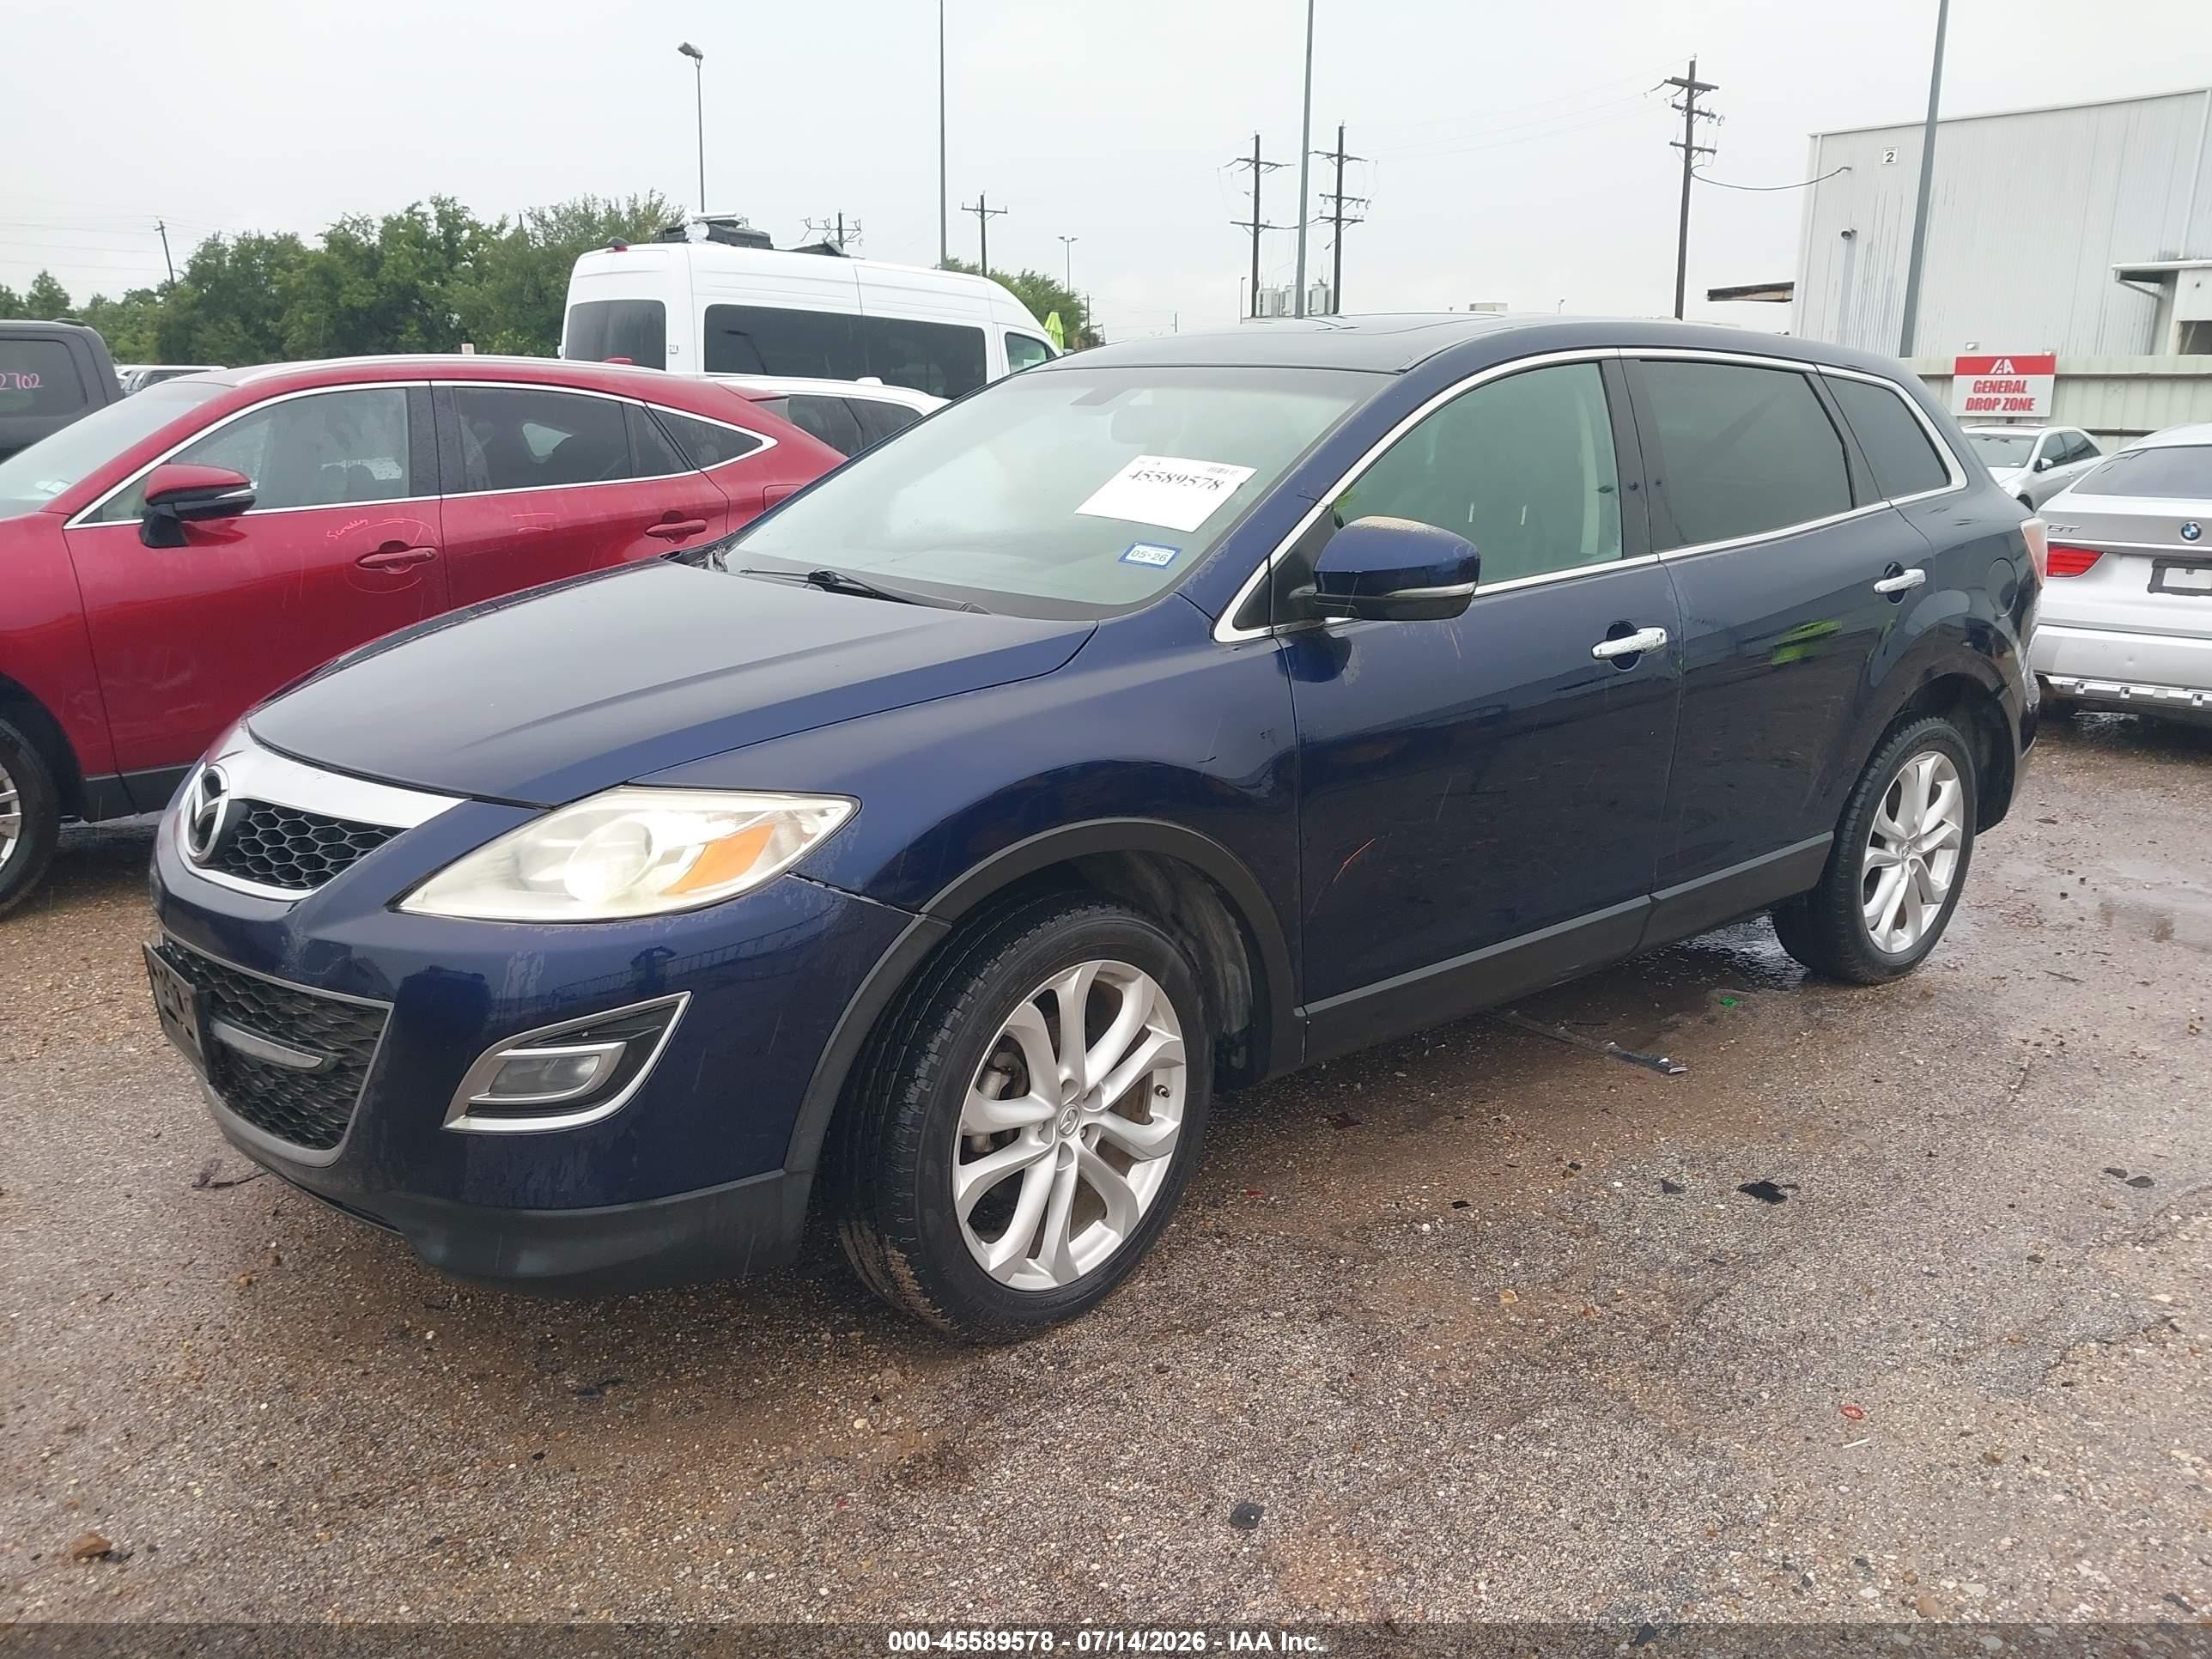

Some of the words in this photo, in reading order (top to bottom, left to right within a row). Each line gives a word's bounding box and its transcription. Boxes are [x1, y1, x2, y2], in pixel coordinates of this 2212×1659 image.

[1885, 151, 1894, 163] 2
[1972, 380, 2027, 393] GENERAL
[1966, 398, 2001, 410] DROP
[2002, 398, 2035, 411] ZONE
[1127, 469, 1224, 491] 45589578
